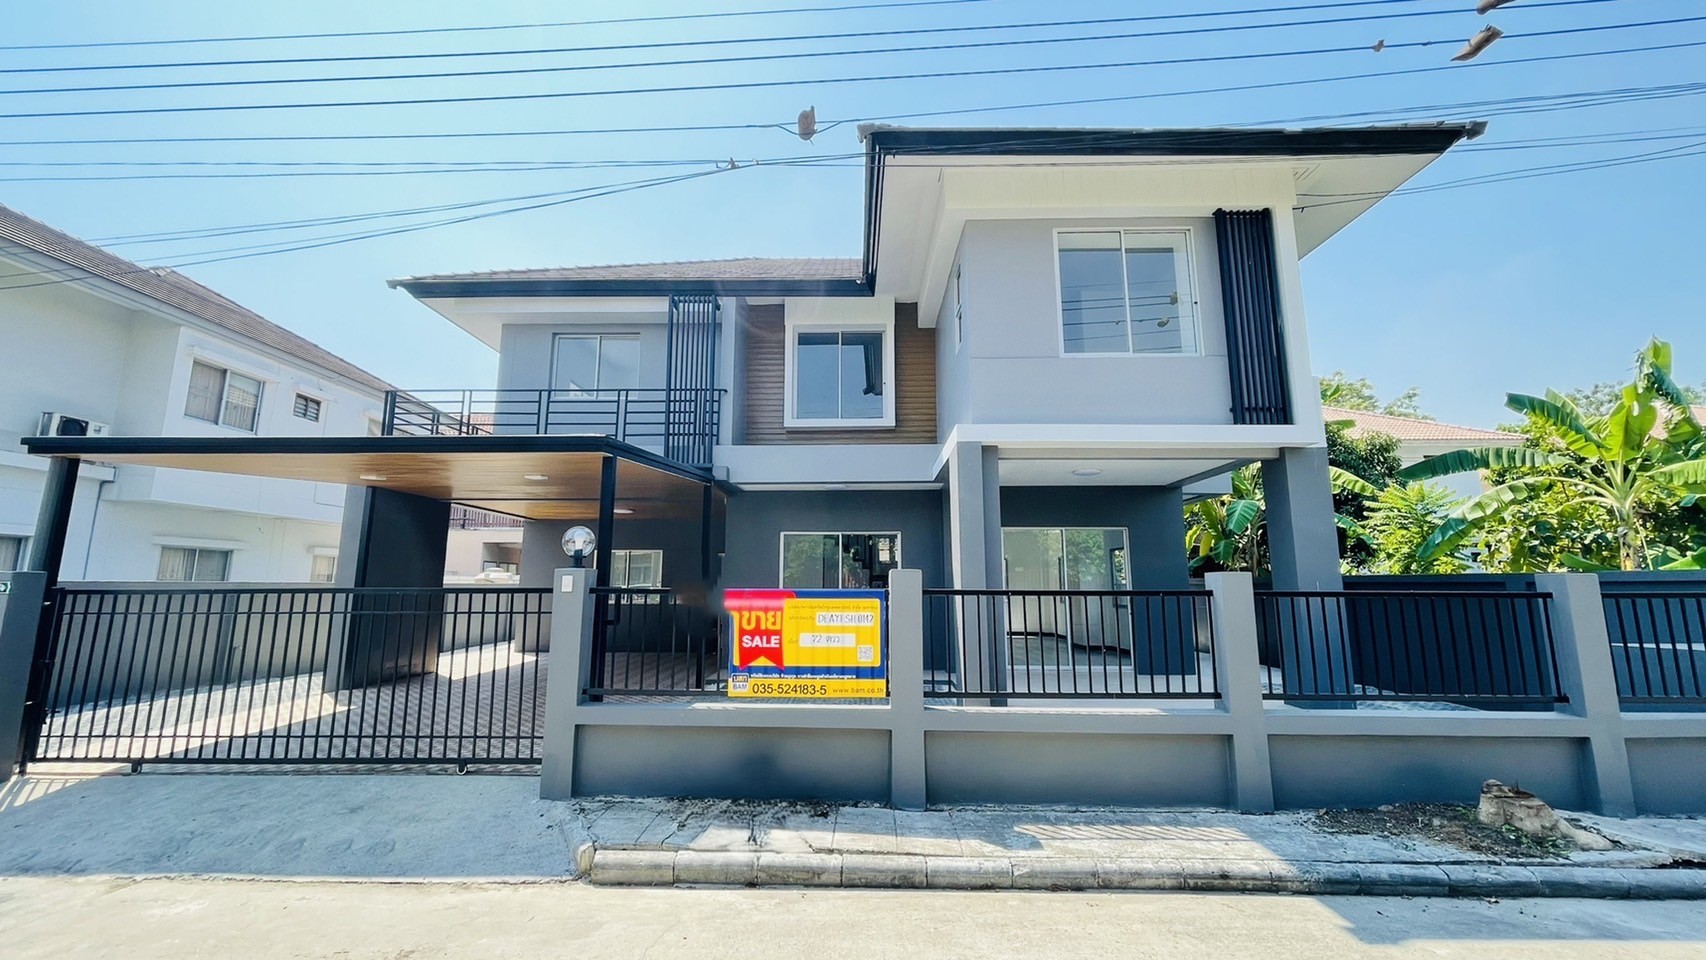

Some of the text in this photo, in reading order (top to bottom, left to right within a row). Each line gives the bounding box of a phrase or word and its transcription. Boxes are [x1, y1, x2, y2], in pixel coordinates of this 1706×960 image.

[741, 610, 782, 630] ขาย
[741, 635, 780, 648] SALE
[752, 683, 827, 695] 035-524183-5
